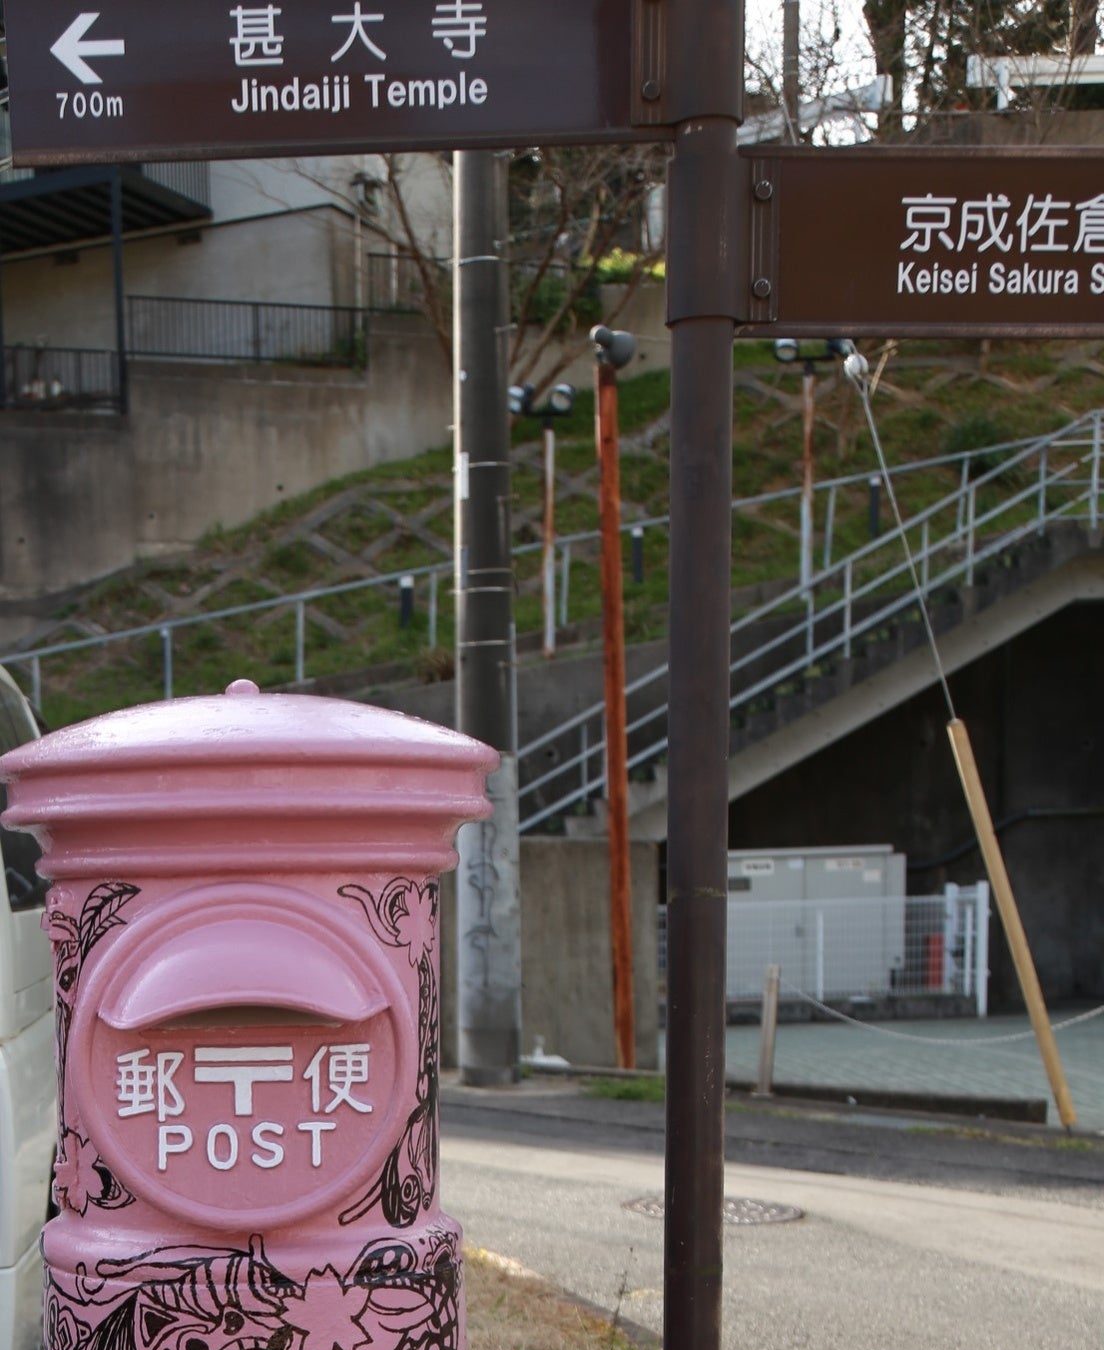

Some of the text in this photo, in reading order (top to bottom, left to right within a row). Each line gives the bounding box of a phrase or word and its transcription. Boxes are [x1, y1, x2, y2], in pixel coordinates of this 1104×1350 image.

[55, 91, 124, 119] 700m
[231, 71, 488, 113] Jindaiji Temple
[897, 261, 978, 294] Keisei
[988, 262, 1079, 294] Sakura
[158, 1121, 337, 1171] POST
